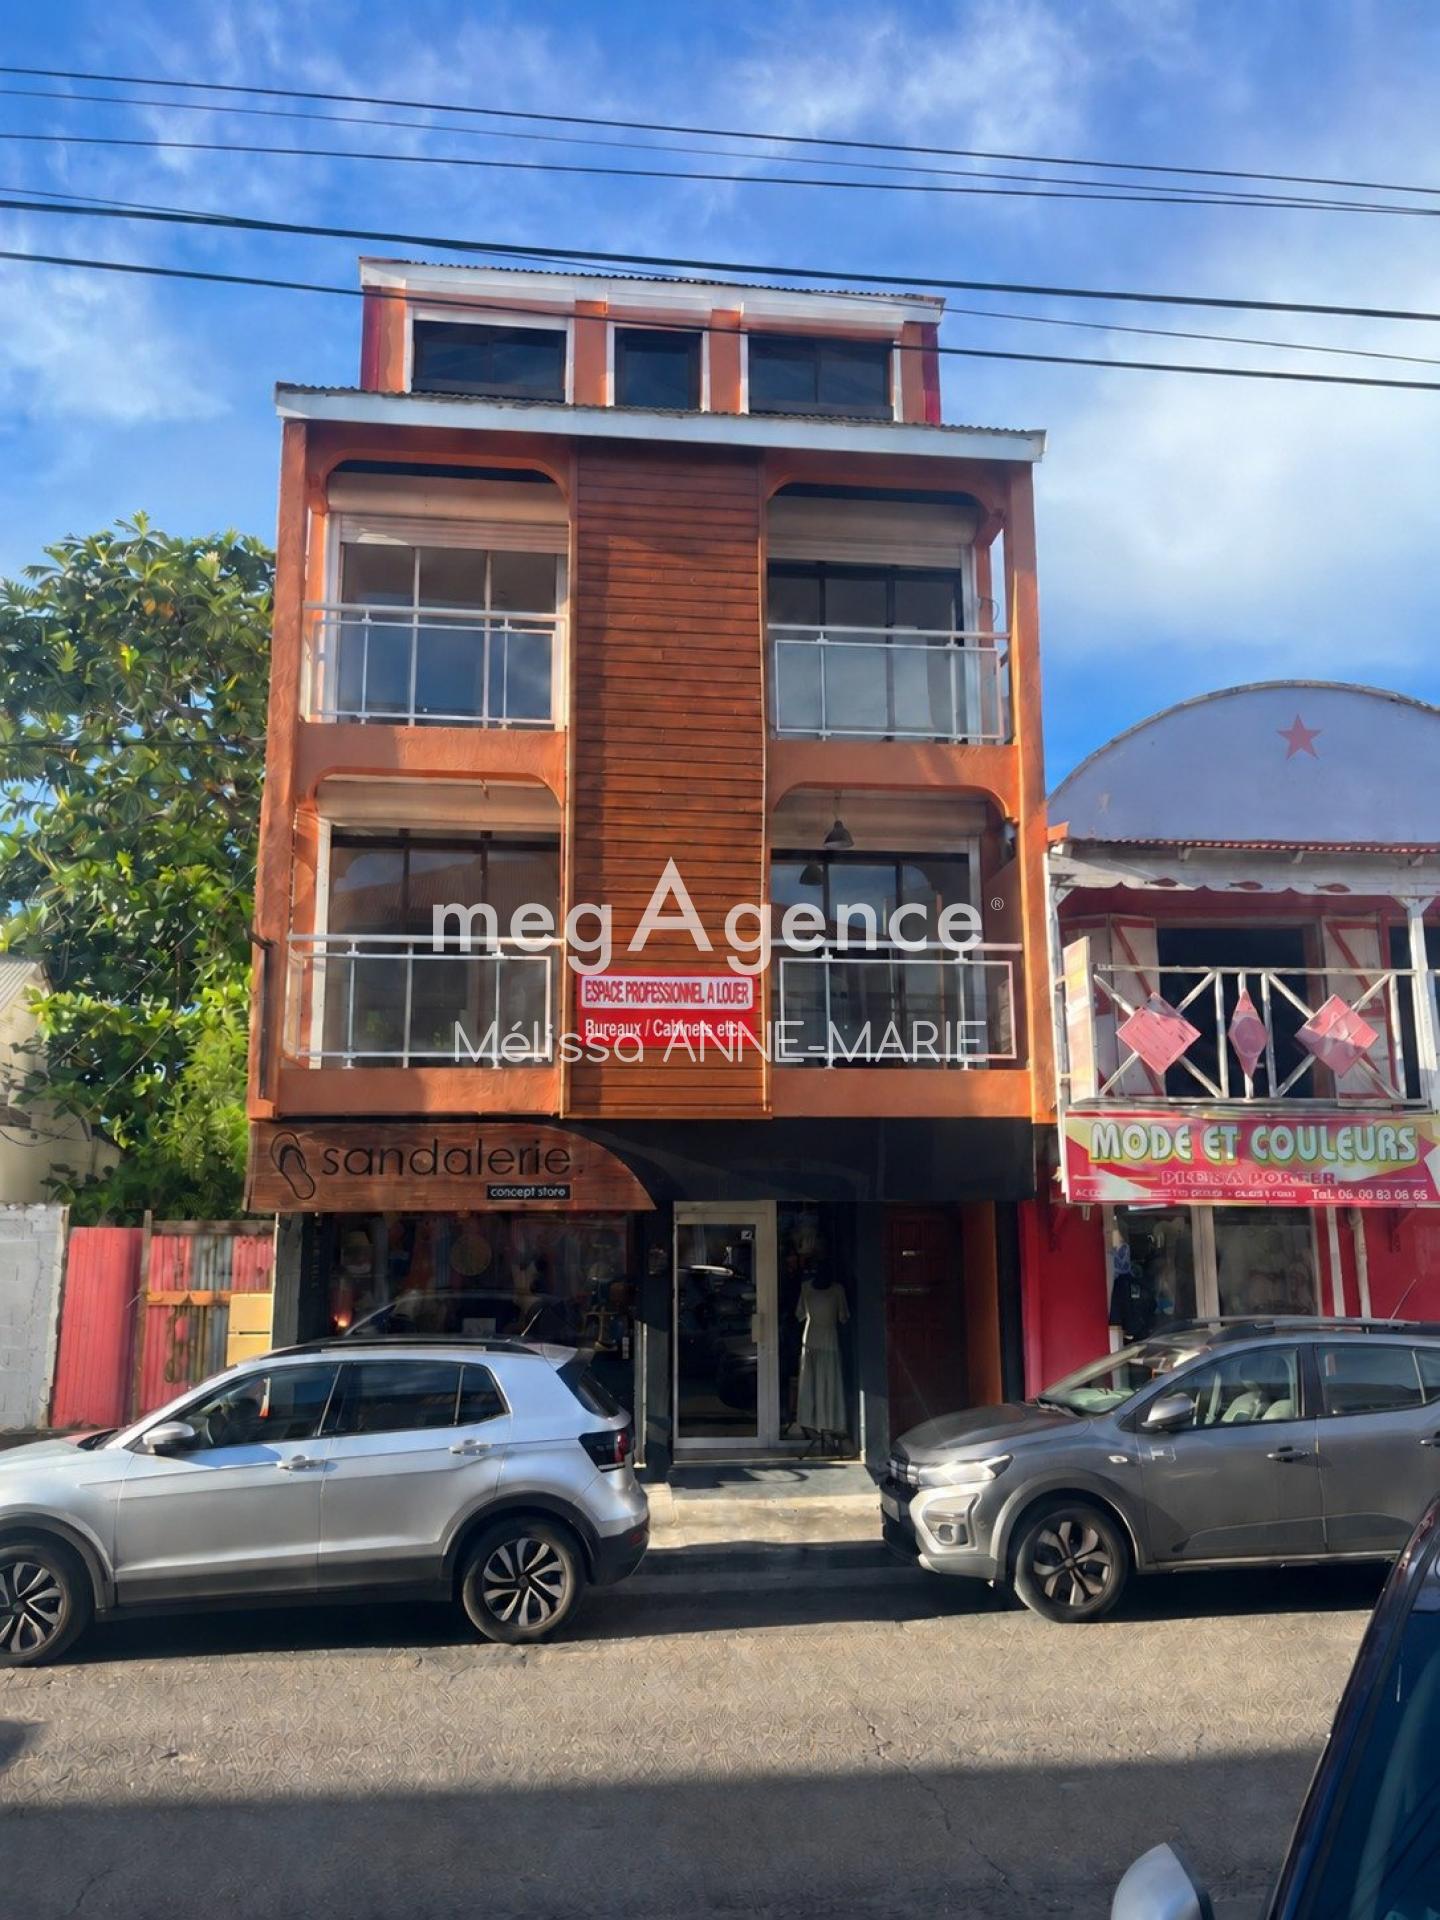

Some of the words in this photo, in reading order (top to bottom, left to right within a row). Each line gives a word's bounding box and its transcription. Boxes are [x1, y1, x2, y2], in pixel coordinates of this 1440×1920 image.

[585, 980, 624, 1002] ESPACE
[626, 981, 704, 1003] PROFESSIONNEL
[717, 982, 750, 1004] LOUER
[585, 1019, 641, 1037] Bureaux
[653, 1019, 712, 1037] Cabinets
[1090, 1122, 1192, 1161] MODE
[1203, 1124, 1239, 1161] ET
[1250, 1124, 1418, 1162] COULEURS
[490, 1187, 535, 1198] concept
[538, 1187, 566, 1196] store
